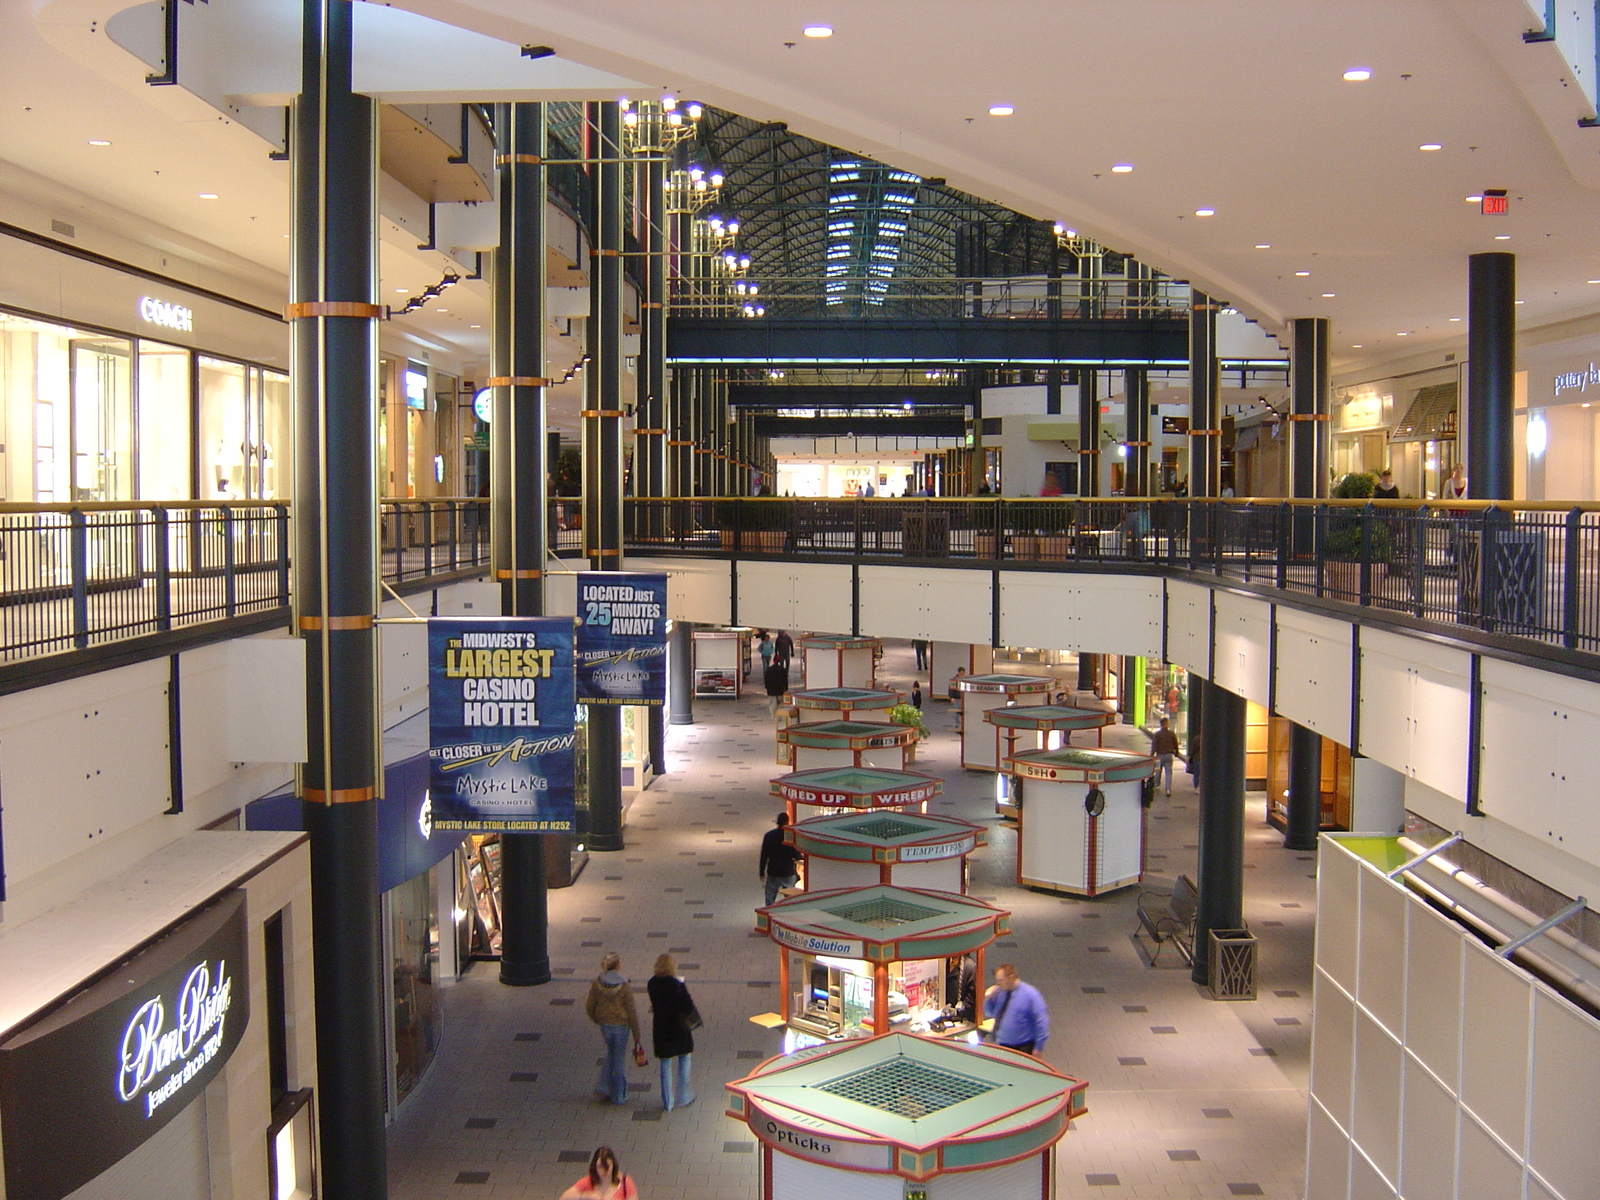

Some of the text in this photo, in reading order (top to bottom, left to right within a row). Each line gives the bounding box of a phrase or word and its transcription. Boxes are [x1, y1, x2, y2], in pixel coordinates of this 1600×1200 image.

[1485, 197, 1506, 213] EXIT
[140, 296, 193, 332] COACH
[1554, 371, 1589, 396] pottery
[583, 585, 654, 601] LOCATED JUST
[586, 602, 660, 625] 25 MINUTES
[611, 618, 654, 635] AWAY!
[449, 633, 535, 648] THE MIDWEST'S
[446, 649, 554, 678] LARGEST
[584, 650, 610, 660] CLOSER
[463, 678, 535, 700] CASINO
[464, 702, 539, 726] HOTEL
[429, 749, 440, 757] GET
[442, 744, 482, 760] CLOSER
[488, 734, 575, 766] ACTION
[780, 784, 846, 803] WIRED UP
[876, 788, 925, 804] WIRED
[435, 820, 570, 830] MYSTIC LAKE STORE LOCATED AT N252
[905, 841, 965, 856] TEMPTATIONS
[784, 931, 808, 947] Mobile
[808, 938, 851, 953] Solution
[120, 995, 179, 1101] Ben
[184, 1052, 205, 1084] since
[766, 1121, 831, 1154] Opticks
